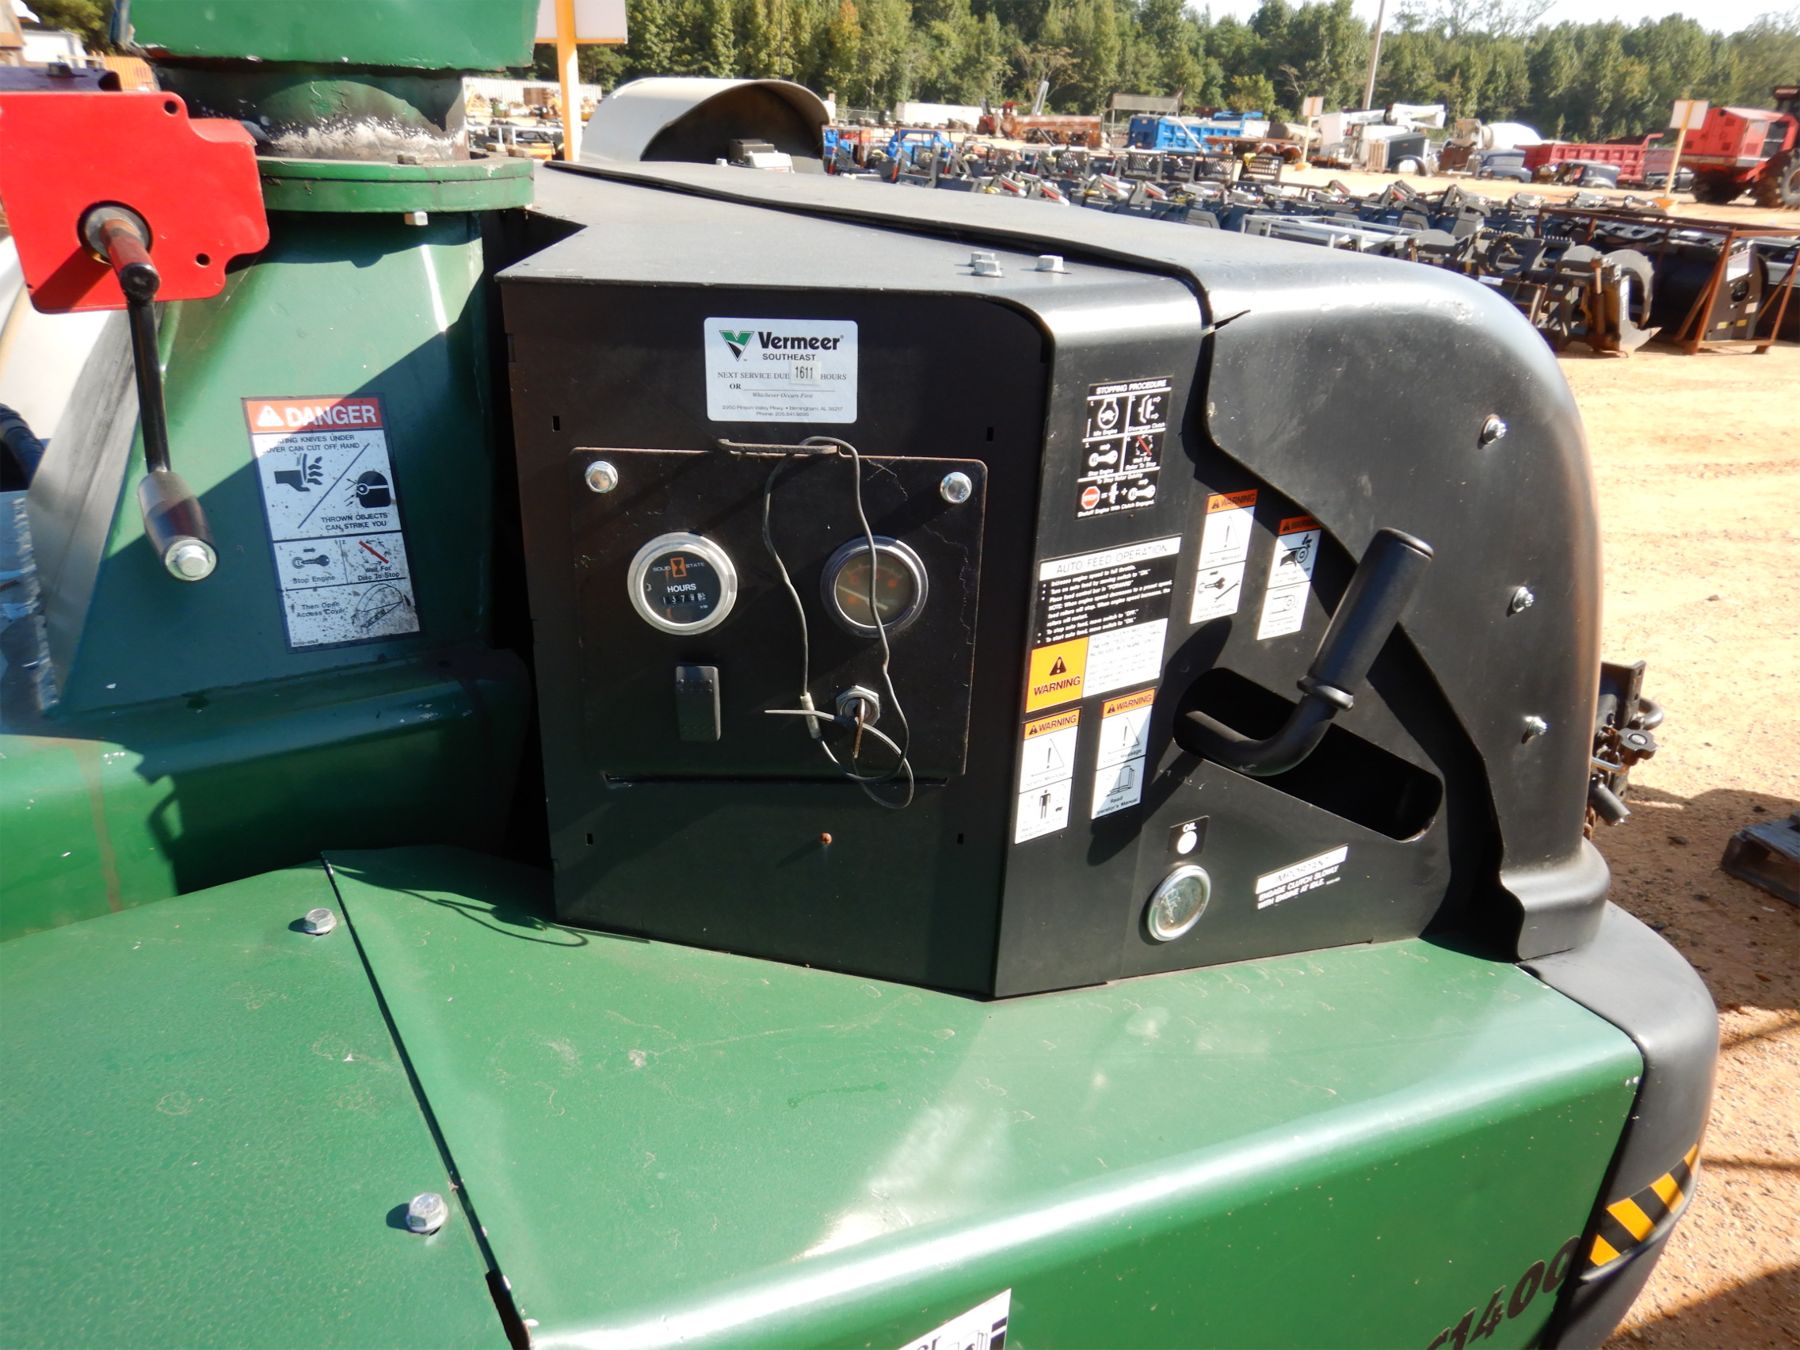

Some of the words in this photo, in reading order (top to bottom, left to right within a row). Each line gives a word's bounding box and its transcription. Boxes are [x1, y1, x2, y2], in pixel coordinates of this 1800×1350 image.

[758, 331, 840, 350] Vermeer
[762, 353, 816, 361] SOUTHEAST
[718, 371, 738, 379] NEXT
[774, 372, 790, 380] DUE
[795, 366, 813, 379] 1611
[1096, 384, 1128, 395] STOPPING
[1129, 379, 1167, 391] PROCEDURE
[285, 405, 377, 427] DANGER
[300, 435, 327, 443] KNIVES
[1057, 561, 1083, 573] AUTO
[1087, 555, 1112, 567] FEED
[1116, 545, 1168, 561] OPERATION
[667, 584, 697, 592] HOURS
[1034, 676, 1081, 696] WARNING
[1117, 694, 1152, 710] WARNING
[1038, 714, 1077, 732] WARNING
[1182, 822, 1197, 833] OIL
[1287, 875, 1313, 890] CLUTCH
[1300, 884, 1309, 893] AT
